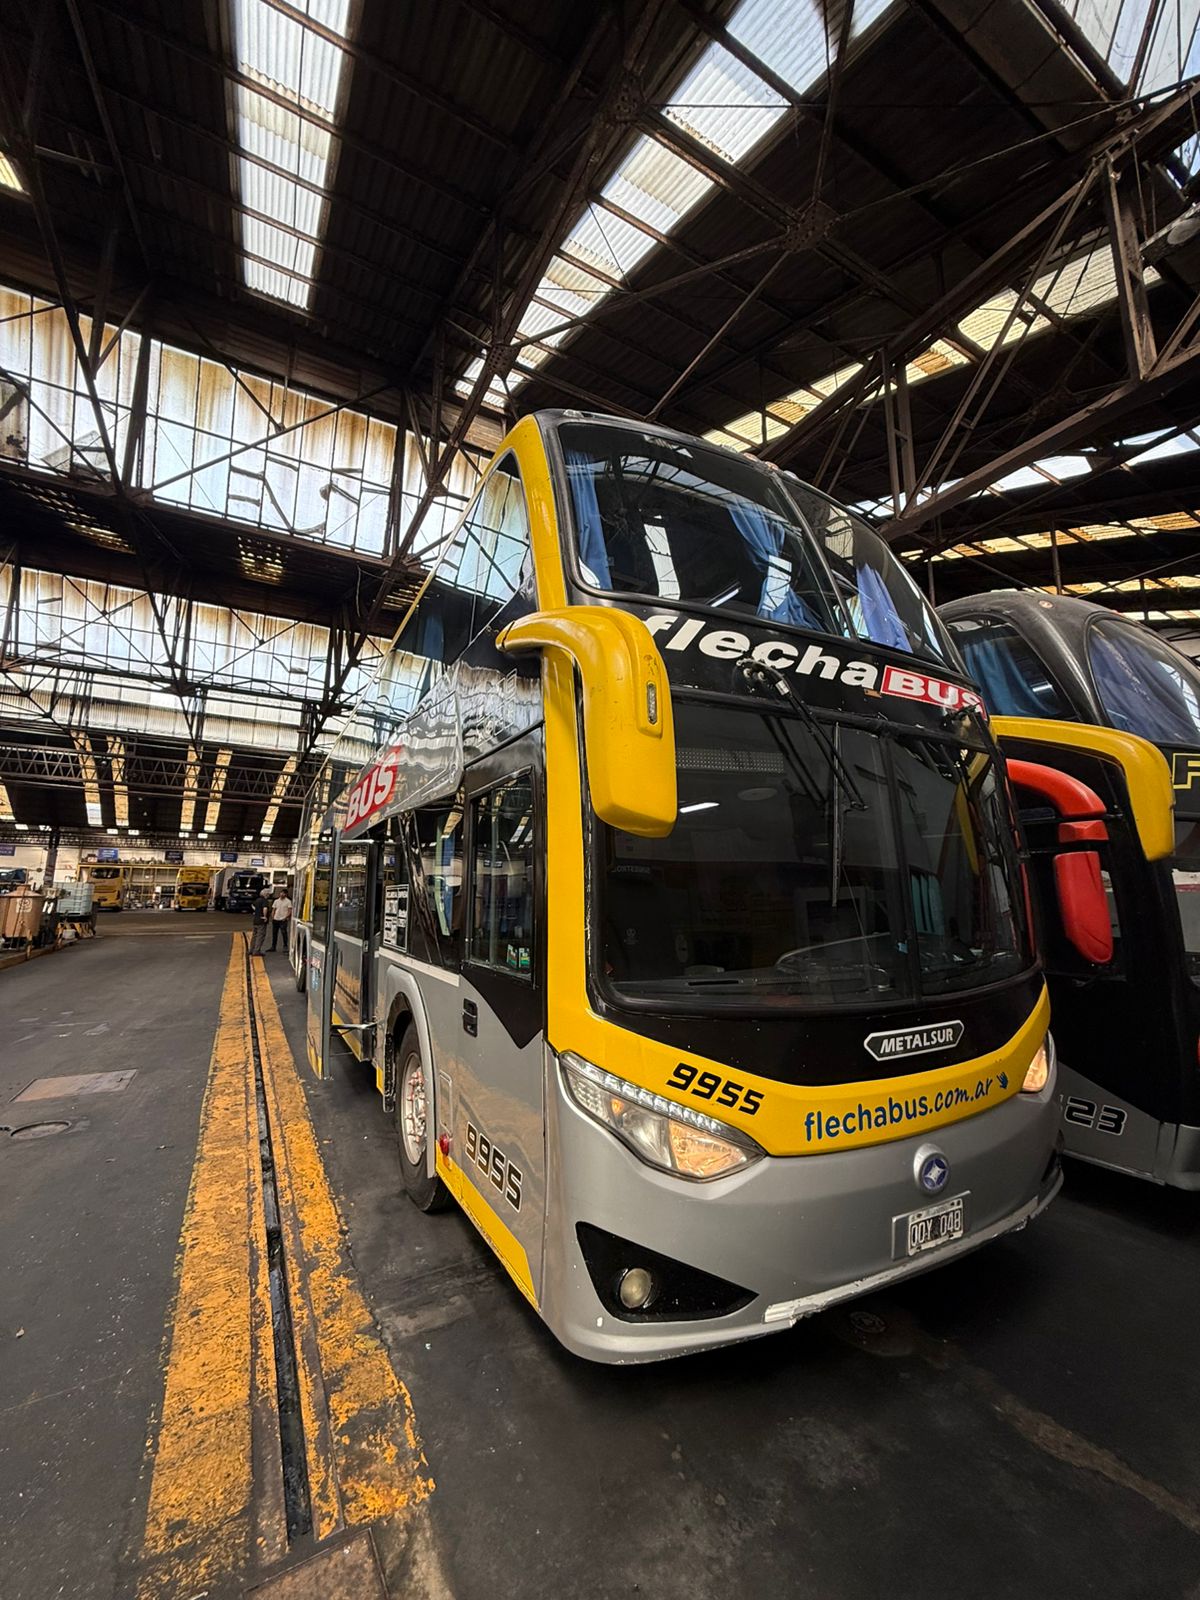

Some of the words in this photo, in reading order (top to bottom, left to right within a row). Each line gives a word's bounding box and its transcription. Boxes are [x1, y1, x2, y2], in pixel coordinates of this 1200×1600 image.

[346, 752, 397, 828] BUS
[880, 1028, 953, 1054] METALSUR
[666, 1062, 765, 1115] 9955
[804, 1078, 992, 1142] flechabus.com.ar
[1060, 1094, 1128, 1136] 23
[465, 1121, 523, 1213] 9955
